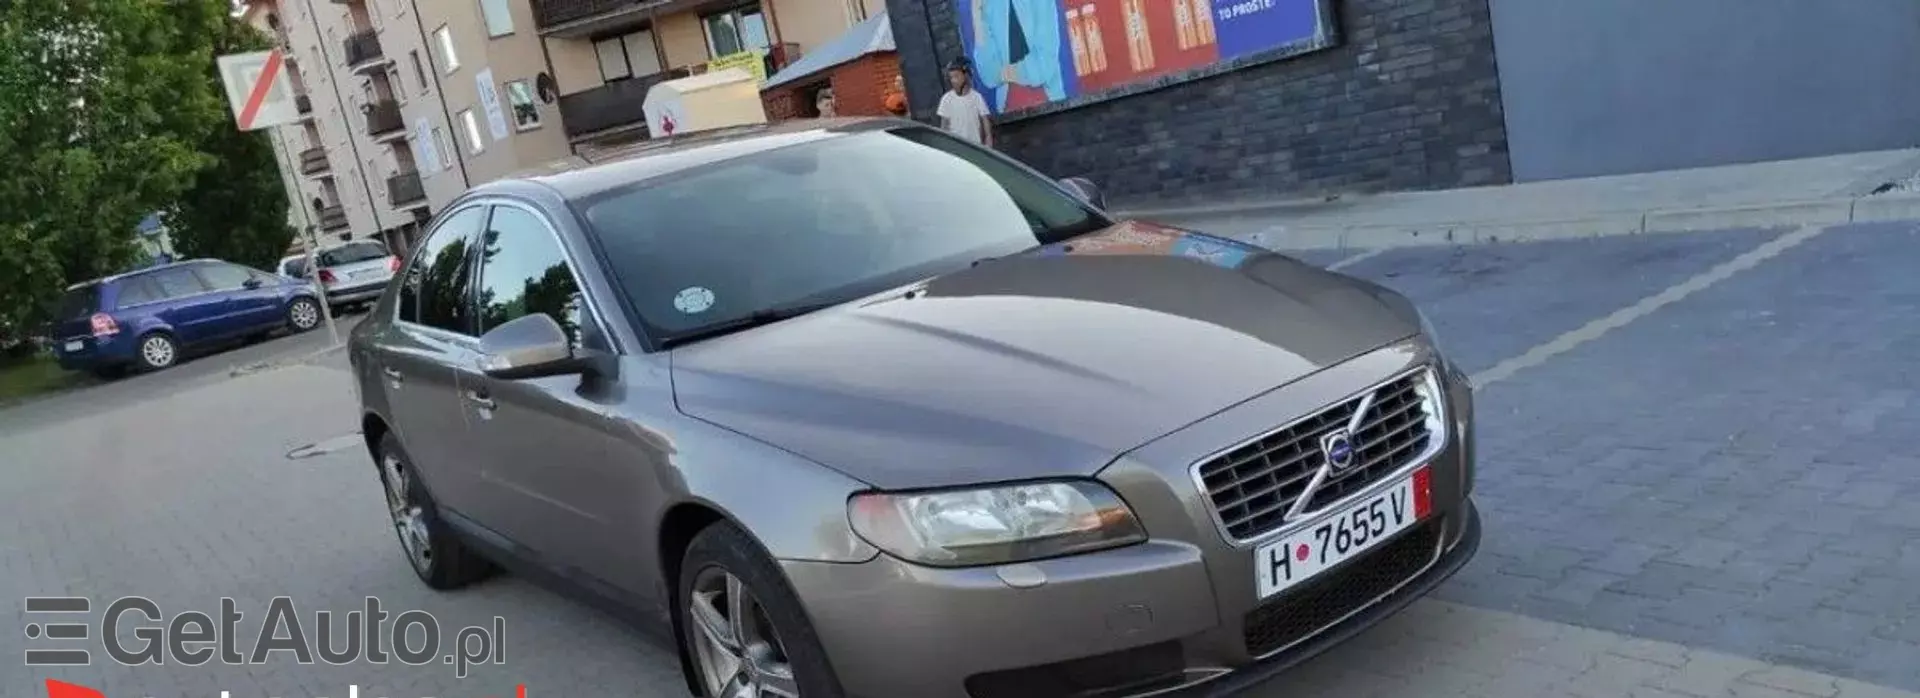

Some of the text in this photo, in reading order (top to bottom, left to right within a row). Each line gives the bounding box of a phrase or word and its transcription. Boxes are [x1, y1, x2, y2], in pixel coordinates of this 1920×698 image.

[1270, 486, 1406, 586] H 7655 V
